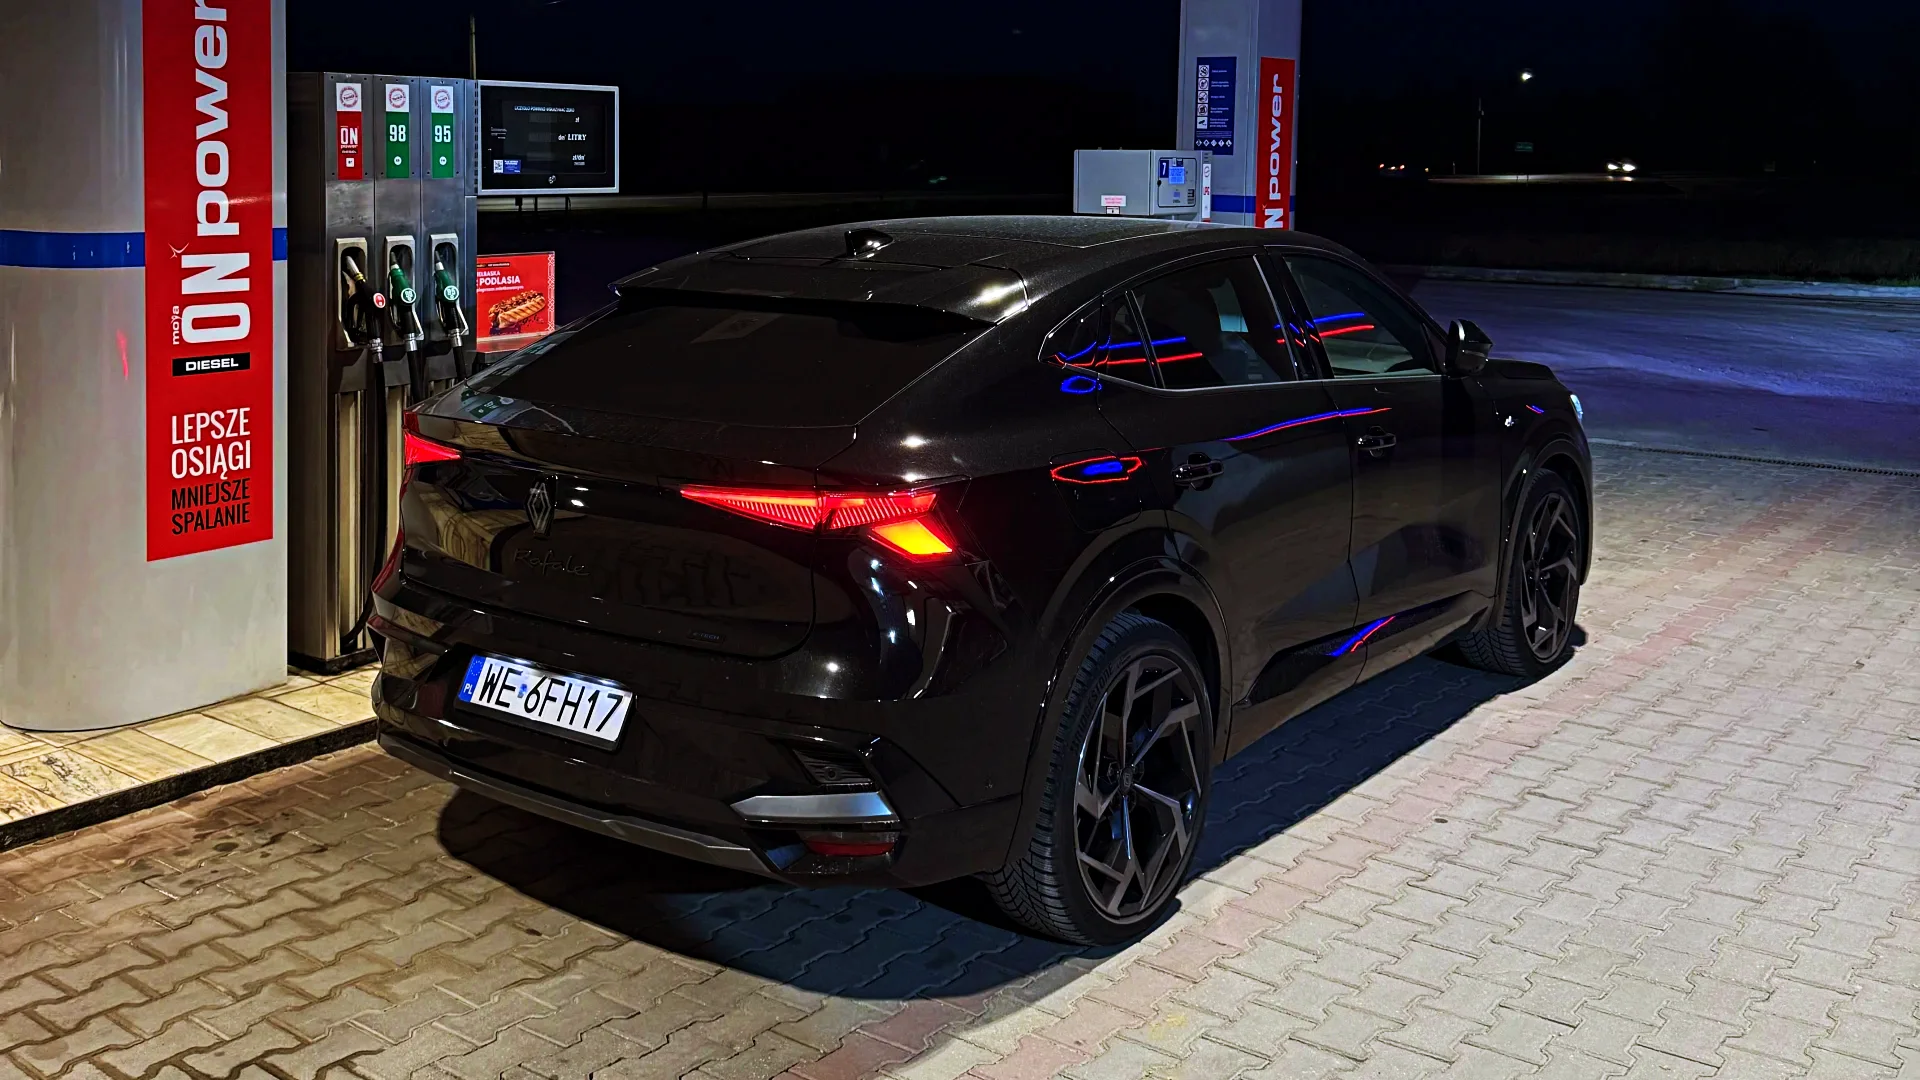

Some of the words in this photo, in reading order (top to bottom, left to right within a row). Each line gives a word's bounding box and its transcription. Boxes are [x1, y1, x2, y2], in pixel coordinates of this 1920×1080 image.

[194, 0, 239, 236] power
[389, 124, 407, 142] 98
[434, 125, 451, 142] 95
[340, 127, 358, 145] ON
[567, 133, 587, 141] LITRY
[1269, 74, 1283, 200] power
[479, 275, 521, 286] PODLASIA
[181, 252, 250, 343] ON
[170, 305, 182, 345] moya
[185, 358, 239, 371] DIESEL
[172, 407, 250, 444] LEPSZE
[171, 440, 251, 480] OSIĄGI
[172, 478, 250, 510] MNIEJSZE
[172, 502, 250, 535] SPALANIE
[463, 682, 473, 695] PL
[478, 663, 523, 709] WE
[523, 675, 624, 733] 6FH17
